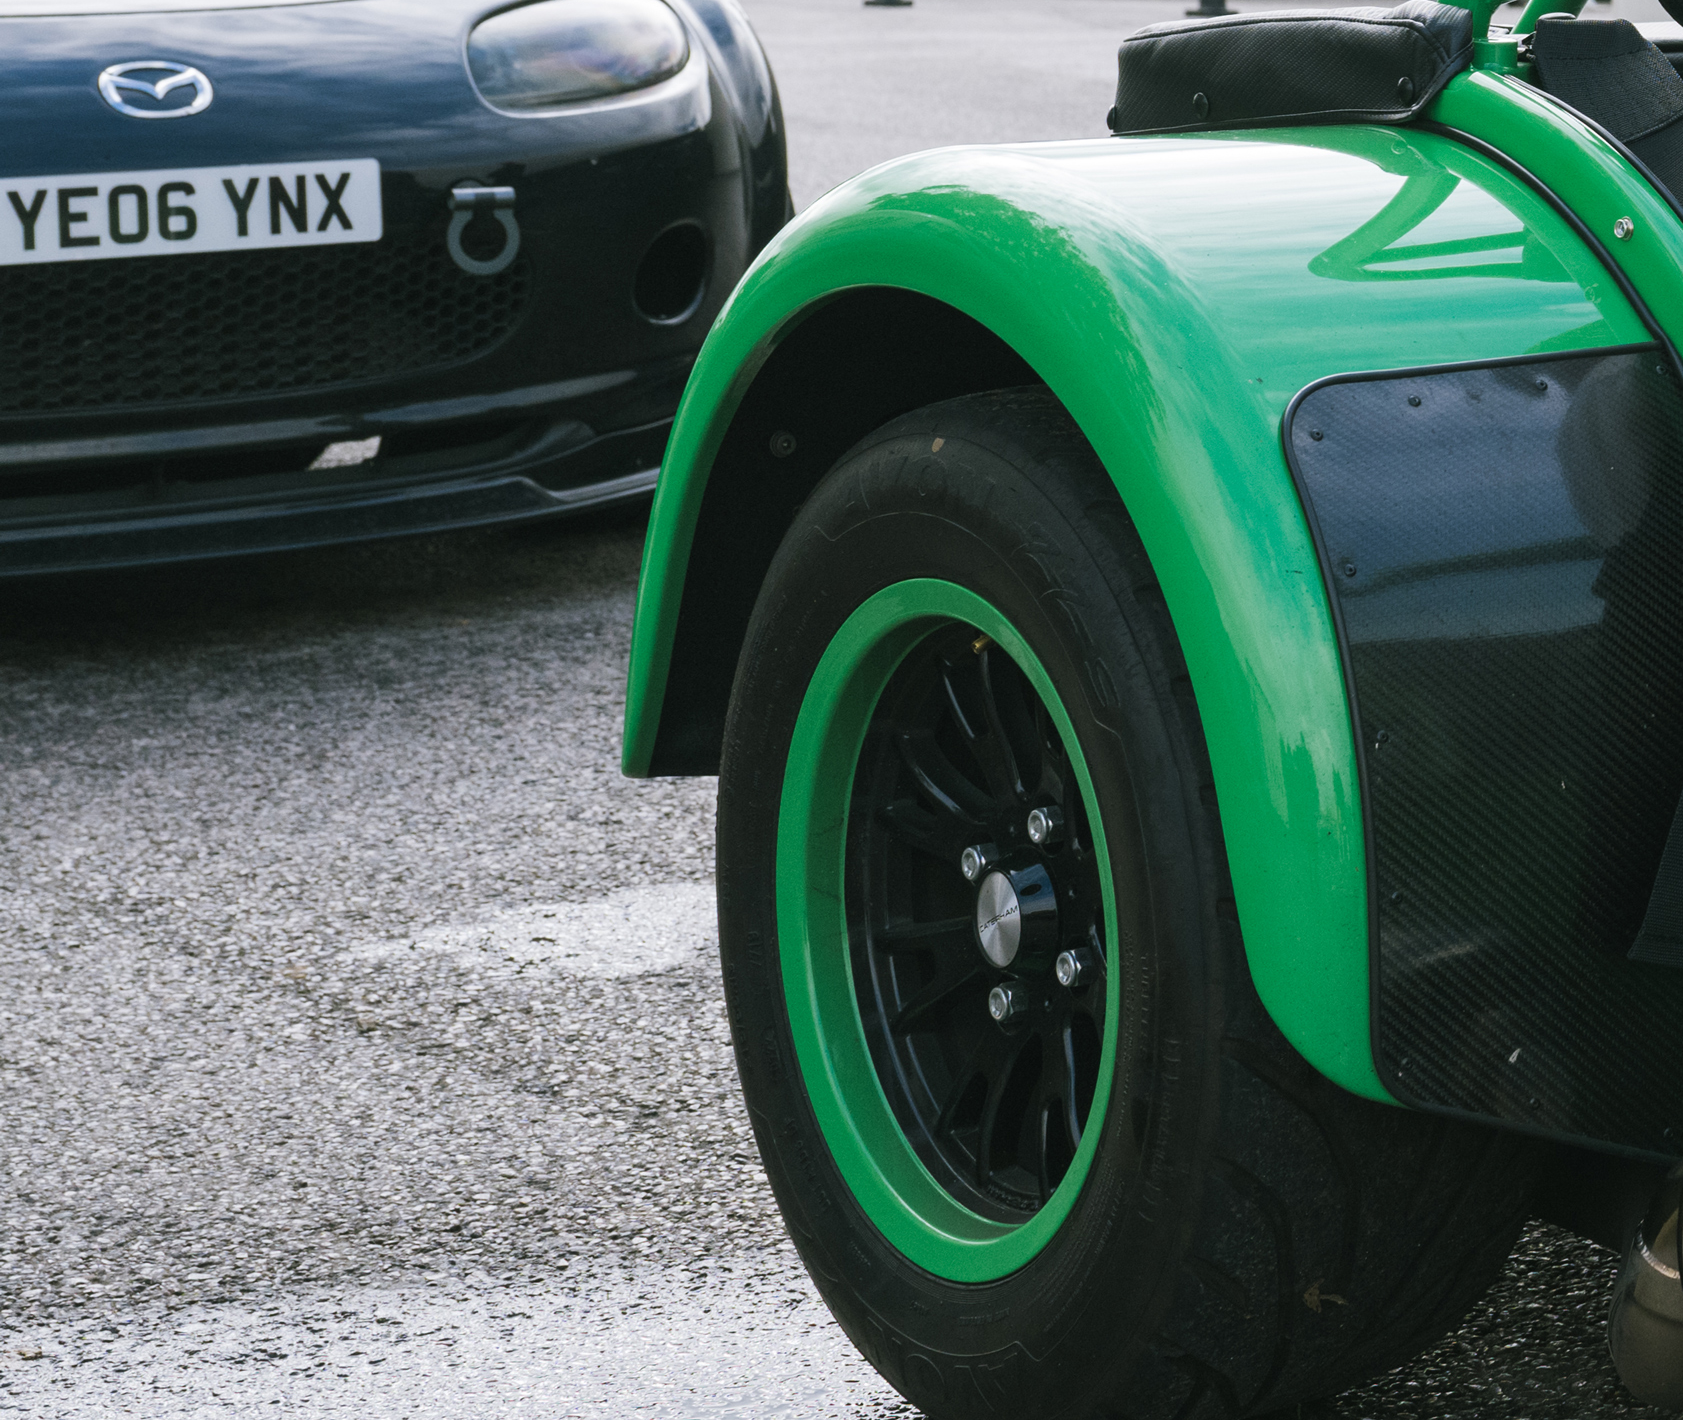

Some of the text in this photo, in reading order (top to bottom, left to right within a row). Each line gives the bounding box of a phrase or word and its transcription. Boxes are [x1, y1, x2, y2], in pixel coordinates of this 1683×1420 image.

[7, 172, 353, 251] YE06 YNX
[979, 904, 1018, 934] CATERHAM
